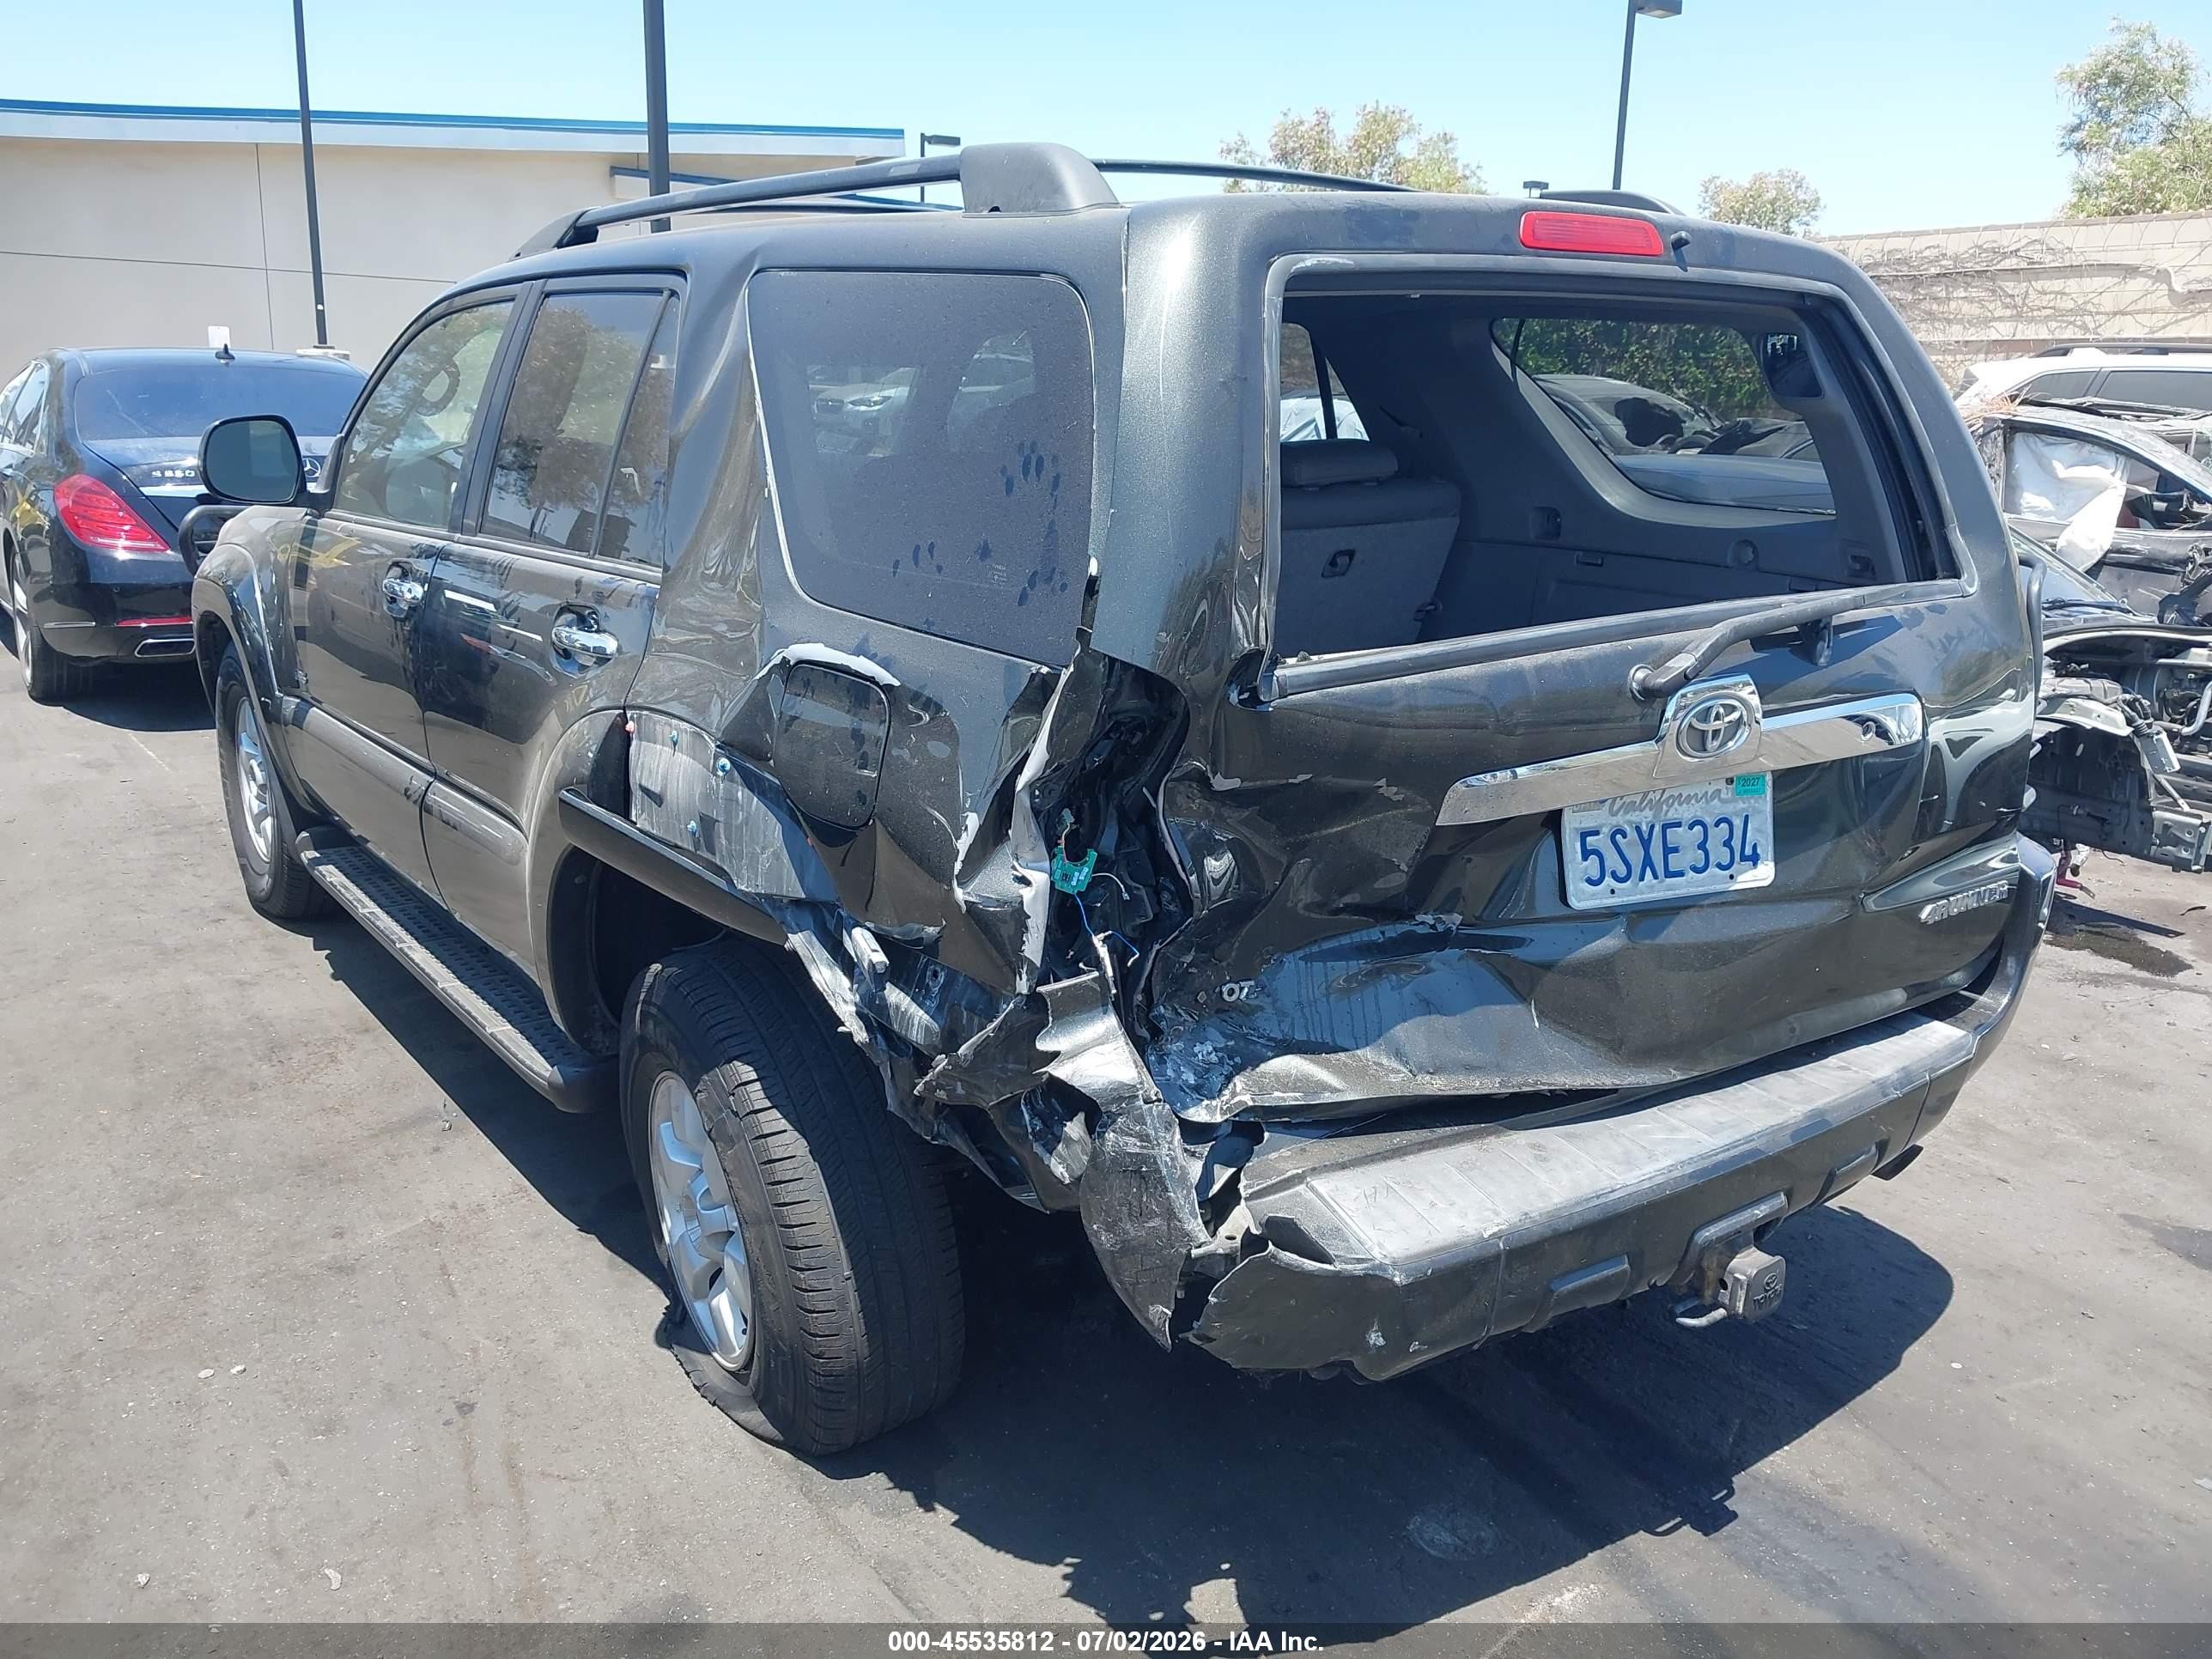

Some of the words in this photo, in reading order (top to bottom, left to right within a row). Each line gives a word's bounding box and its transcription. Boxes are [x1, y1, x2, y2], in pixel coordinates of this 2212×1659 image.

[1740, 776, 1760, 787] 2027
[1607, 787, 1723, 817] California
[1578, 813, 1761, 887] 5SXE334
[1917, 879, 2009, 926] 4RUNNER
[1753, 1284, 1783, 1306] TOYOTA
